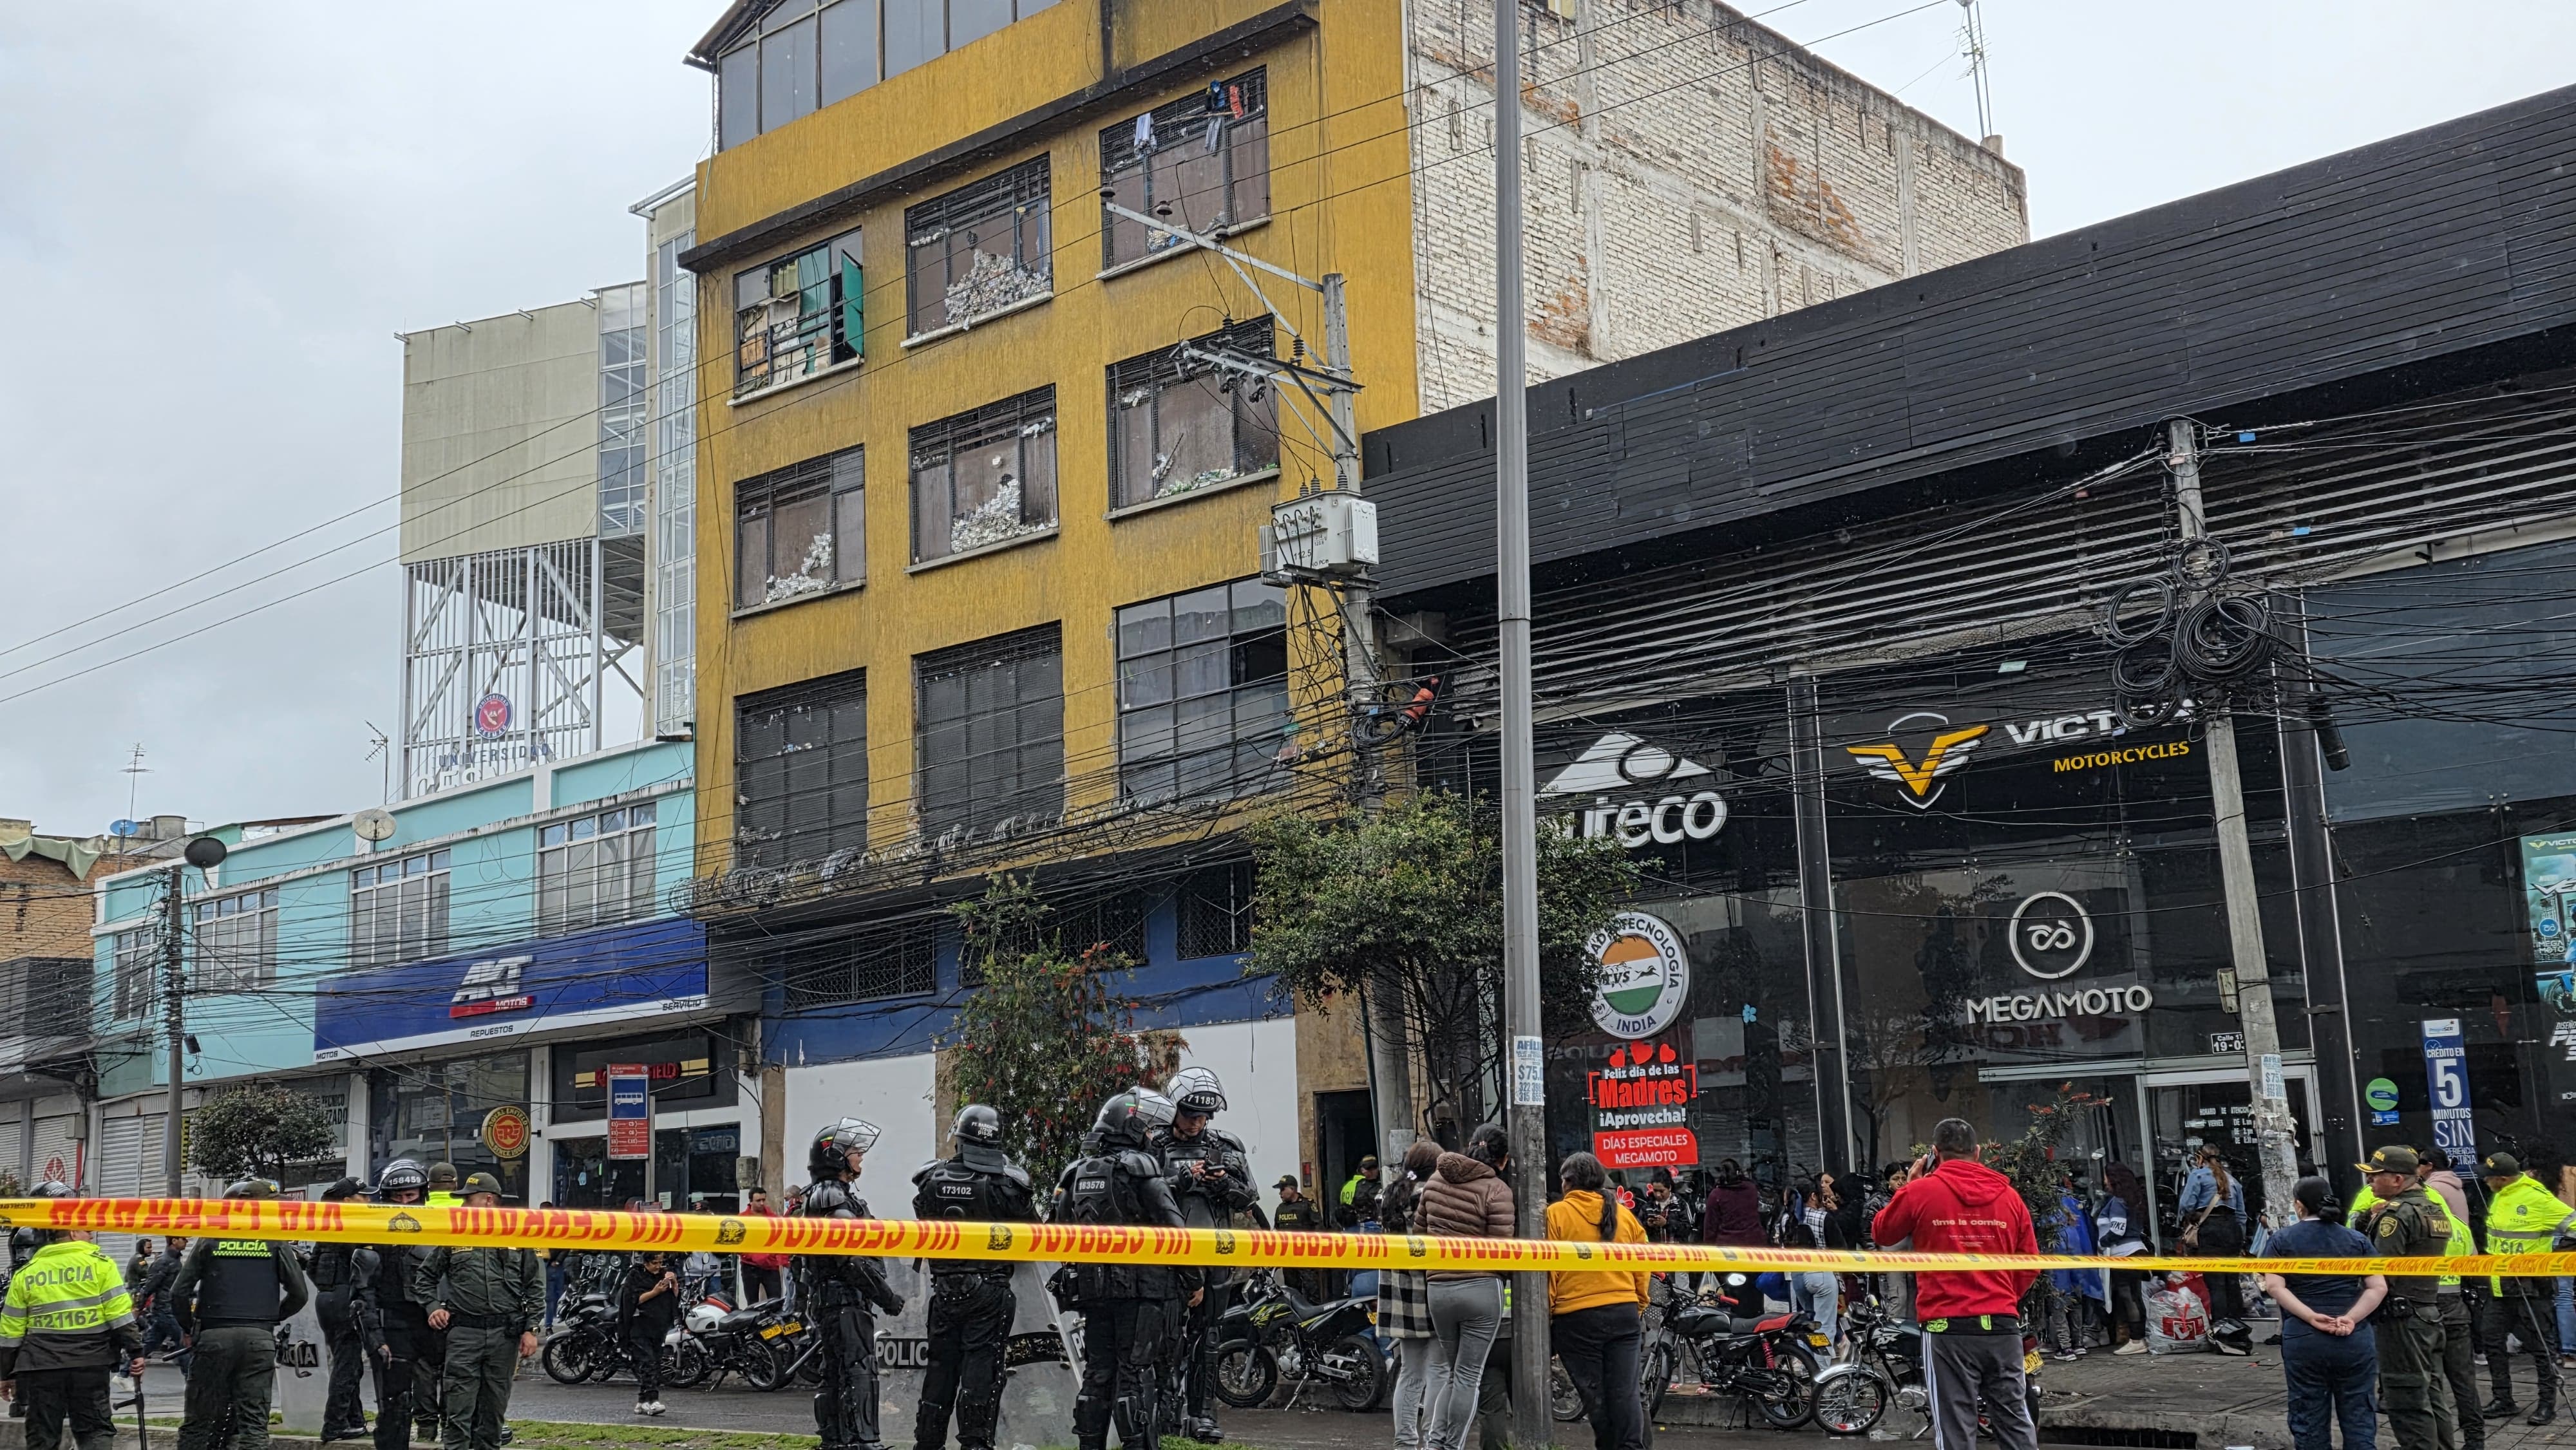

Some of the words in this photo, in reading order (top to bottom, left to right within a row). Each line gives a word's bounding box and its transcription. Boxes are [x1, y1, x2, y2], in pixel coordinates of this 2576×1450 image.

[439, 743, 549, 767] UNIVERSIDAD
[2054, 741, 2189, 772] MOTORCYCLES
[495, 997, 527, 1010] MOTOS
[663, 999, 701, 1010] SERVICIO
[1967, 985, 2153, 1024] MEGAMOTO
[1617, 1015, 1656, 1032] INDIA
[470, 1025, 513, 1038] REPUESTOS
[316, 1051, 338, 1060] MOTOS
[2427, 1047, 2454, 1058] CRÉDITO
[2455, 1046, 2465, 1057] EN
[1604, 1068, 1627, 1079] Feliz
[1629, 1066, 1646, 1078] día
[1648, 1065, 1662, 1076] de
[1664, 1064, 1680, 1075] las
[2436, 1058, 2462, 1107] 5
[1598, 1077, 1687, 1109] Madres
[1600, 1107, 1687, 1129] ¡Aprovecha!
[2433, 1108, 2471, 1120] MINUTOS
[2435, 1120, 2474, 1147] SIN
[1603, 1136, 1626, 1149] DÍAS
[1629, 1135, 1687, 1148] ESPECIALES
[1616, 1151, 1677, 1164] MEGAMOTO
[2443, 1147, 2476, 1156] PERIENCIA
[389, 1175, 421, 1186] 158459
[942, 1185, 972, 1195] 173102
[1971, 1219, 2007, 1229] coming
[218, 1238, 268, 1252] POLICÍA
[24, 1265, 94, 1291] POLICIA
[875, 1341, 929, 1366] POLIC
